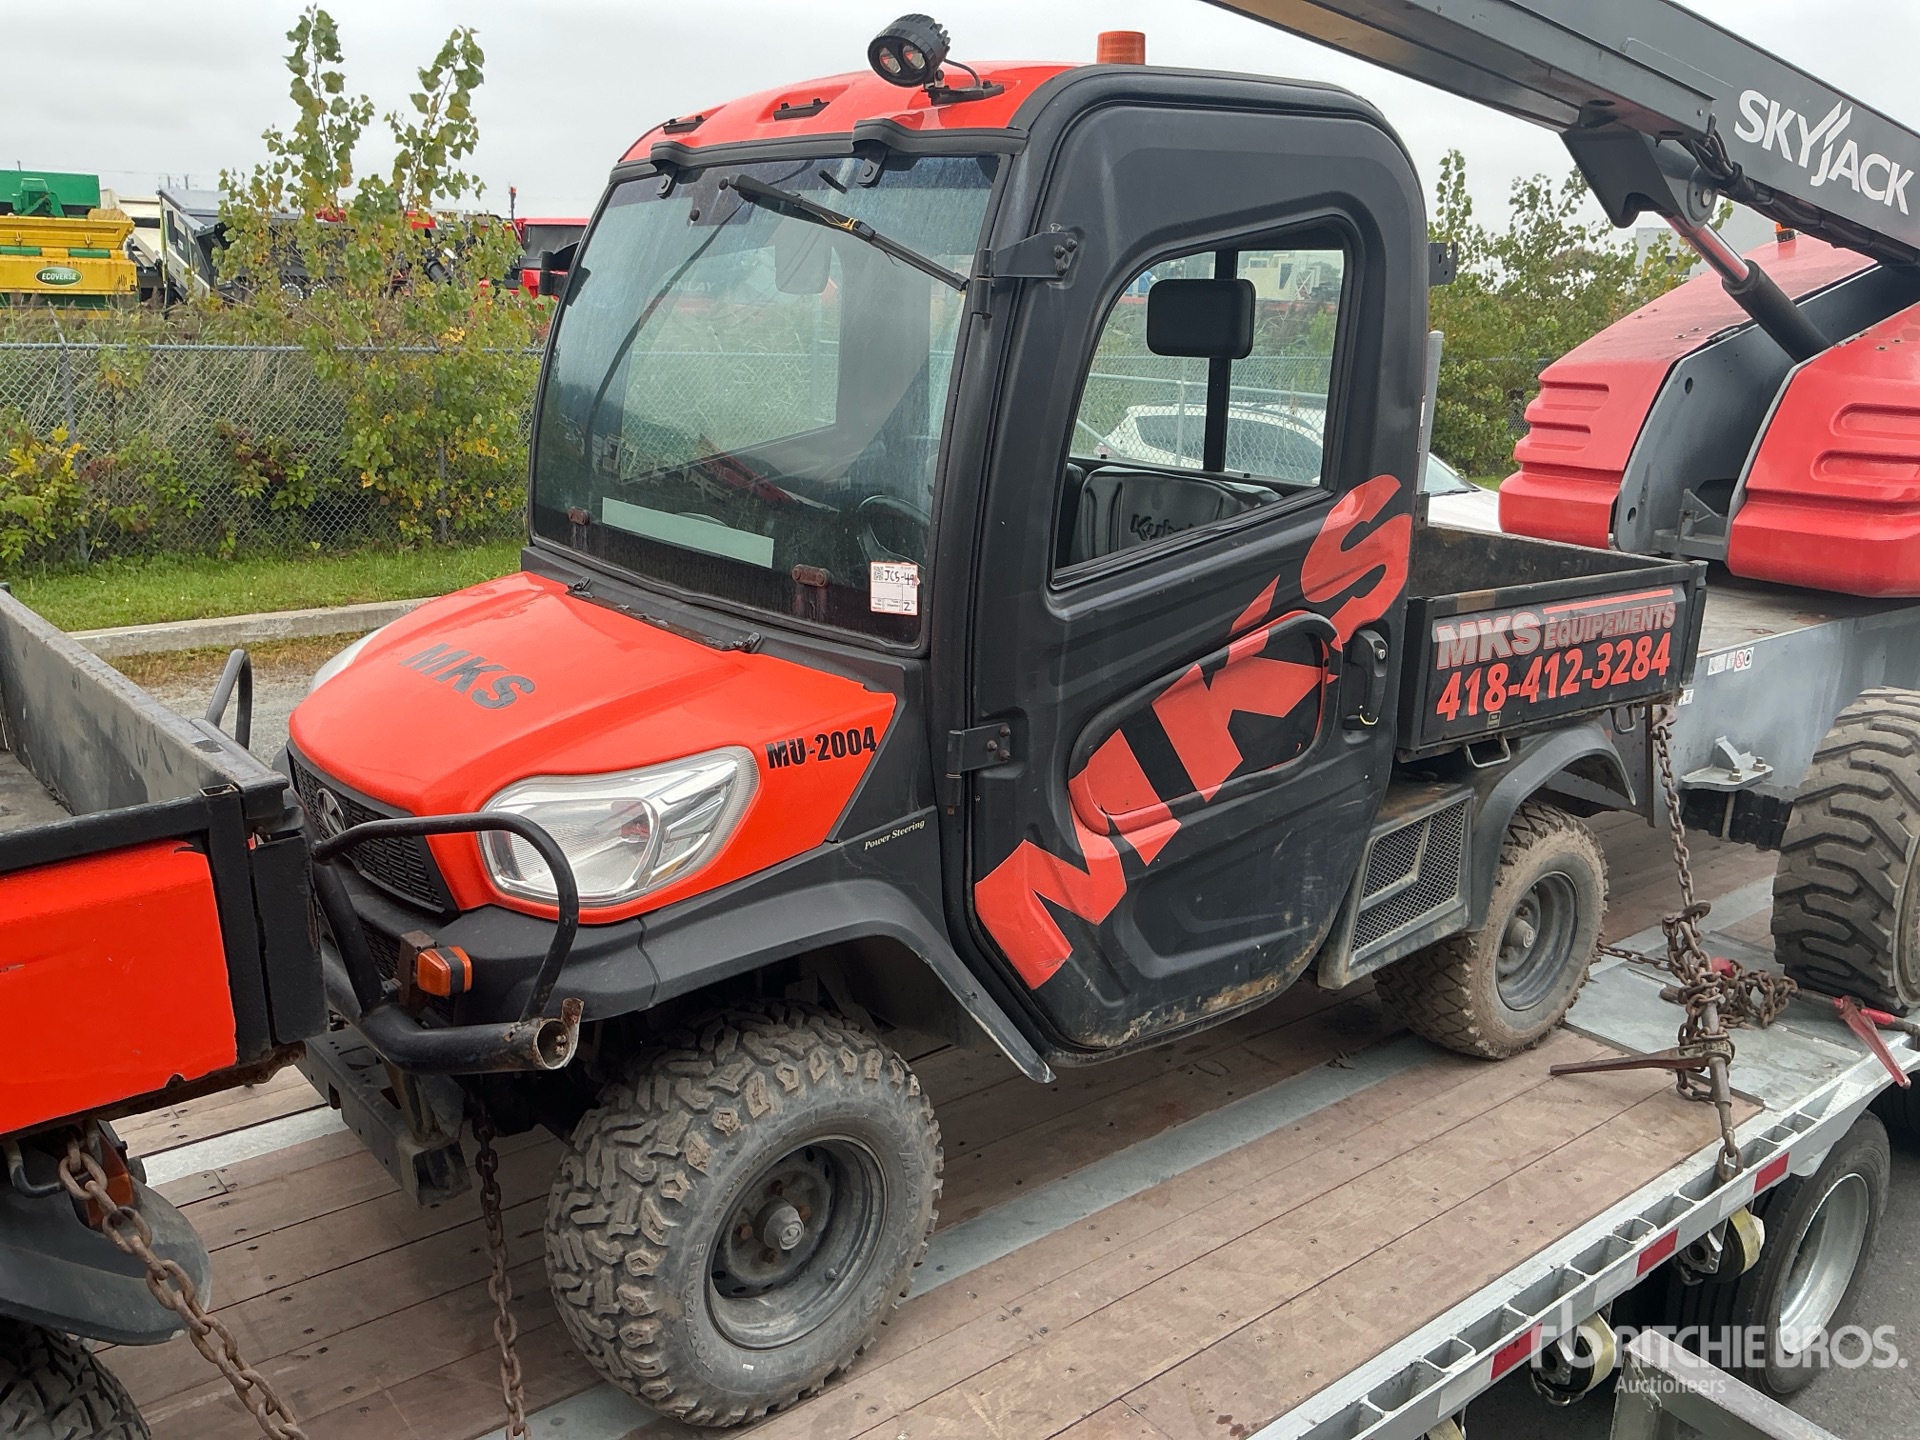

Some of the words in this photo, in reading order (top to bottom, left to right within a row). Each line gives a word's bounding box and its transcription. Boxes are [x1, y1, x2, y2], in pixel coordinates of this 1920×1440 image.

[1734, 90, 1914, 216] SKYJACK
[41, 272, 77, 281] ECOVERSE
[1130, 514, 1194, 541] Kub
[1436, 612, 1541, 670] MKS
[399, 643, 536, 709] MKS
[1436, 632, 1672, 721] 418-412-3284
[765, 726, 877, 769] MU-2004
[975, 474, 1412, 989] MKS
[864, 835, 891, 850] Power
[892, 820, 925, 839] Steering
